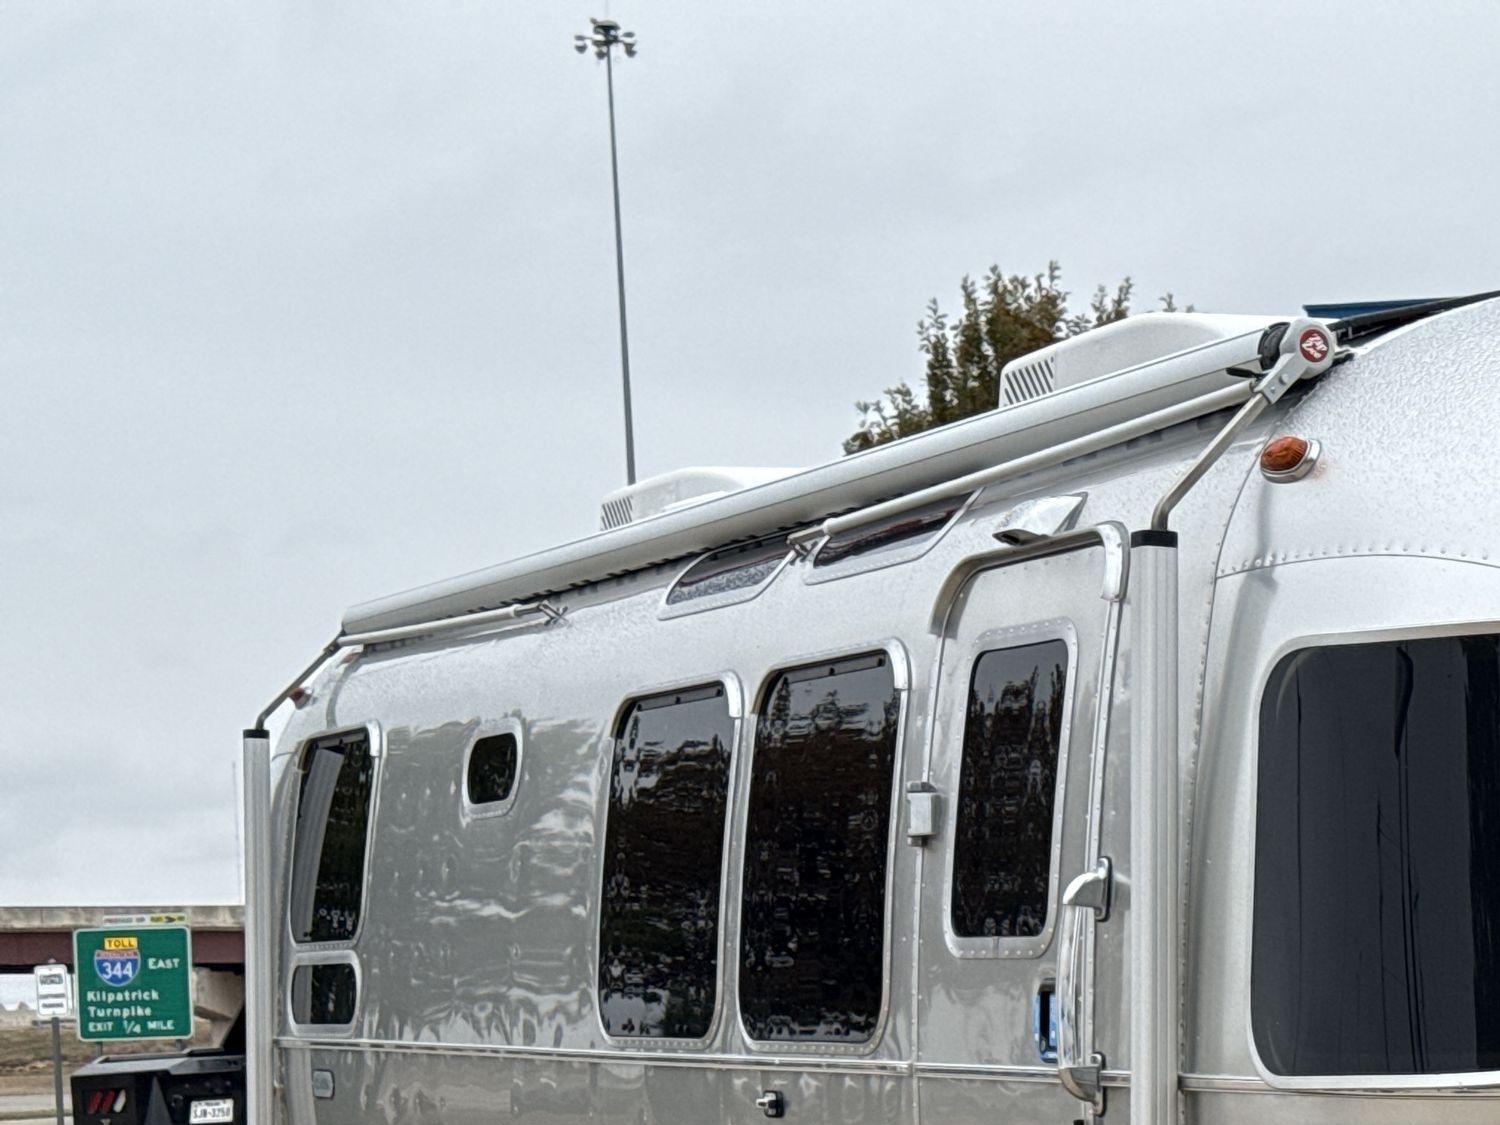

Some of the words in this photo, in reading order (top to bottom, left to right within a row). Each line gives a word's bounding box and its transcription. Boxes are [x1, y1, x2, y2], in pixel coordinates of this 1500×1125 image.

[107, 939, 135, 948] TOLL
[102, 961, 133, 979] 344
[148, 958, 180, 969] EAST
[87, 989, 160, 1004] Kilpatrick
[88, 1005, 152, 1019] Turnpike
[88, 1022, 114, 1032] EXIT
[147, 1020, 175, 1030] MILE
